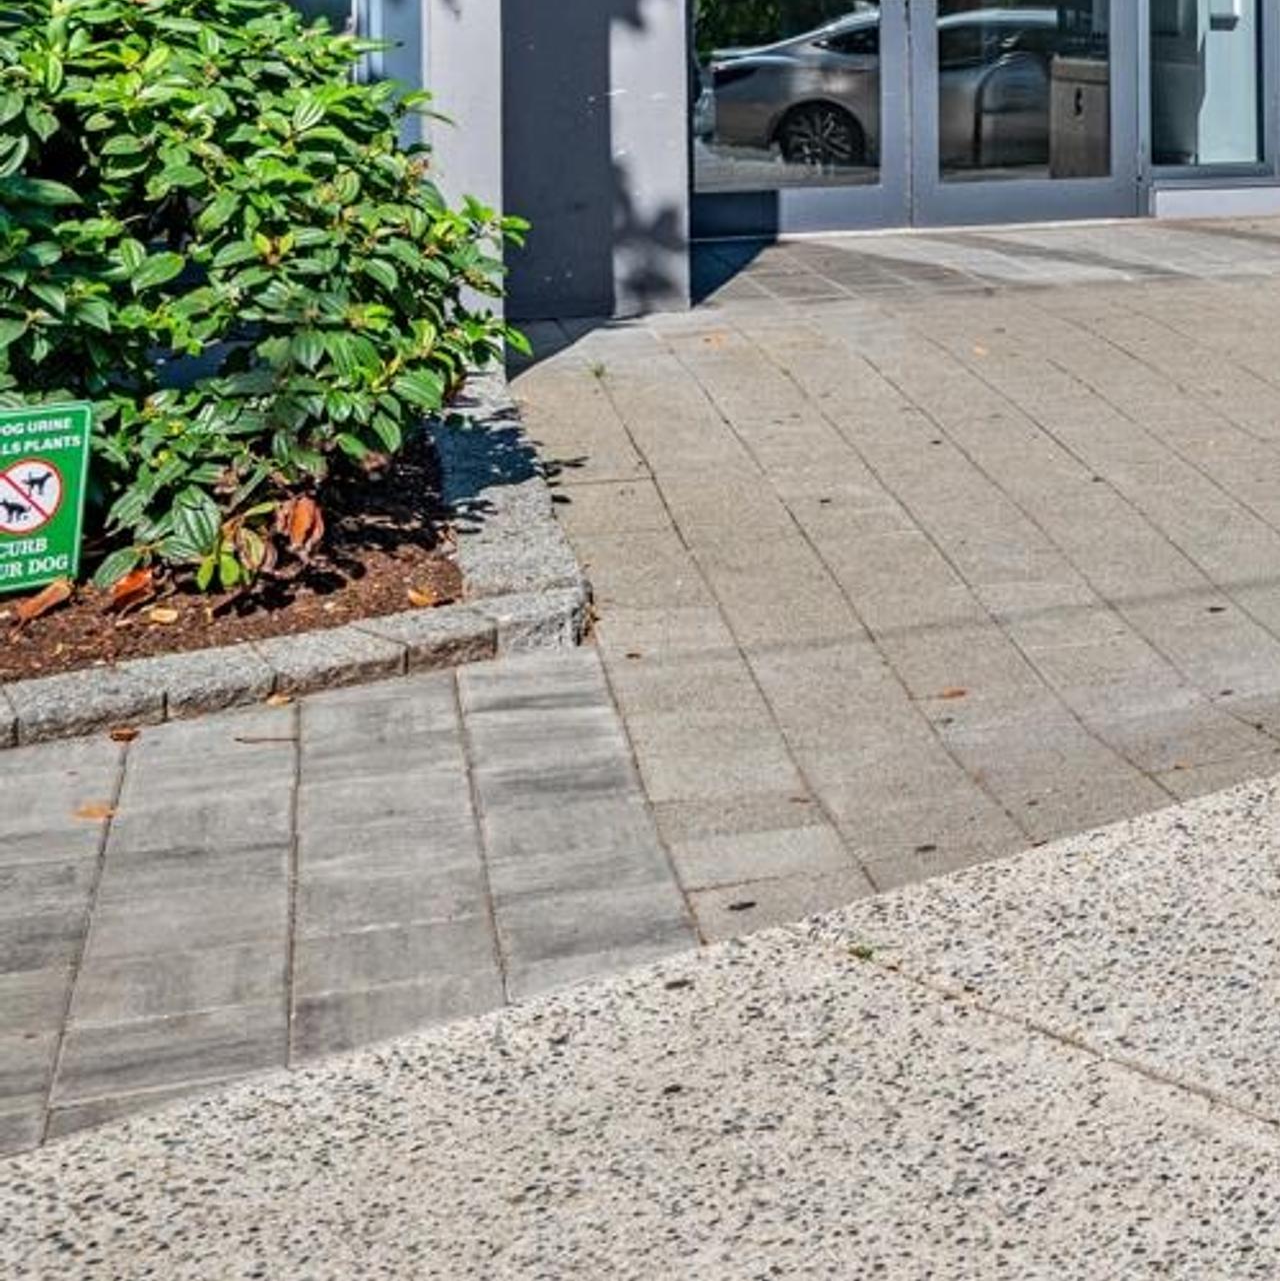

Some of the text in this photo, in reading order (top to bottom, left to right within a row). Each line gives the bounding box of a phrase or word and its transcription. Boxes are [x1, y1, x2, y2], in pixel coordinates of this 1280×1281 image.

[0, 417, 73, 436] OG URINE
[23, 435, 81, 453] PLANTS
[28, 554, 69, 575] DOG
